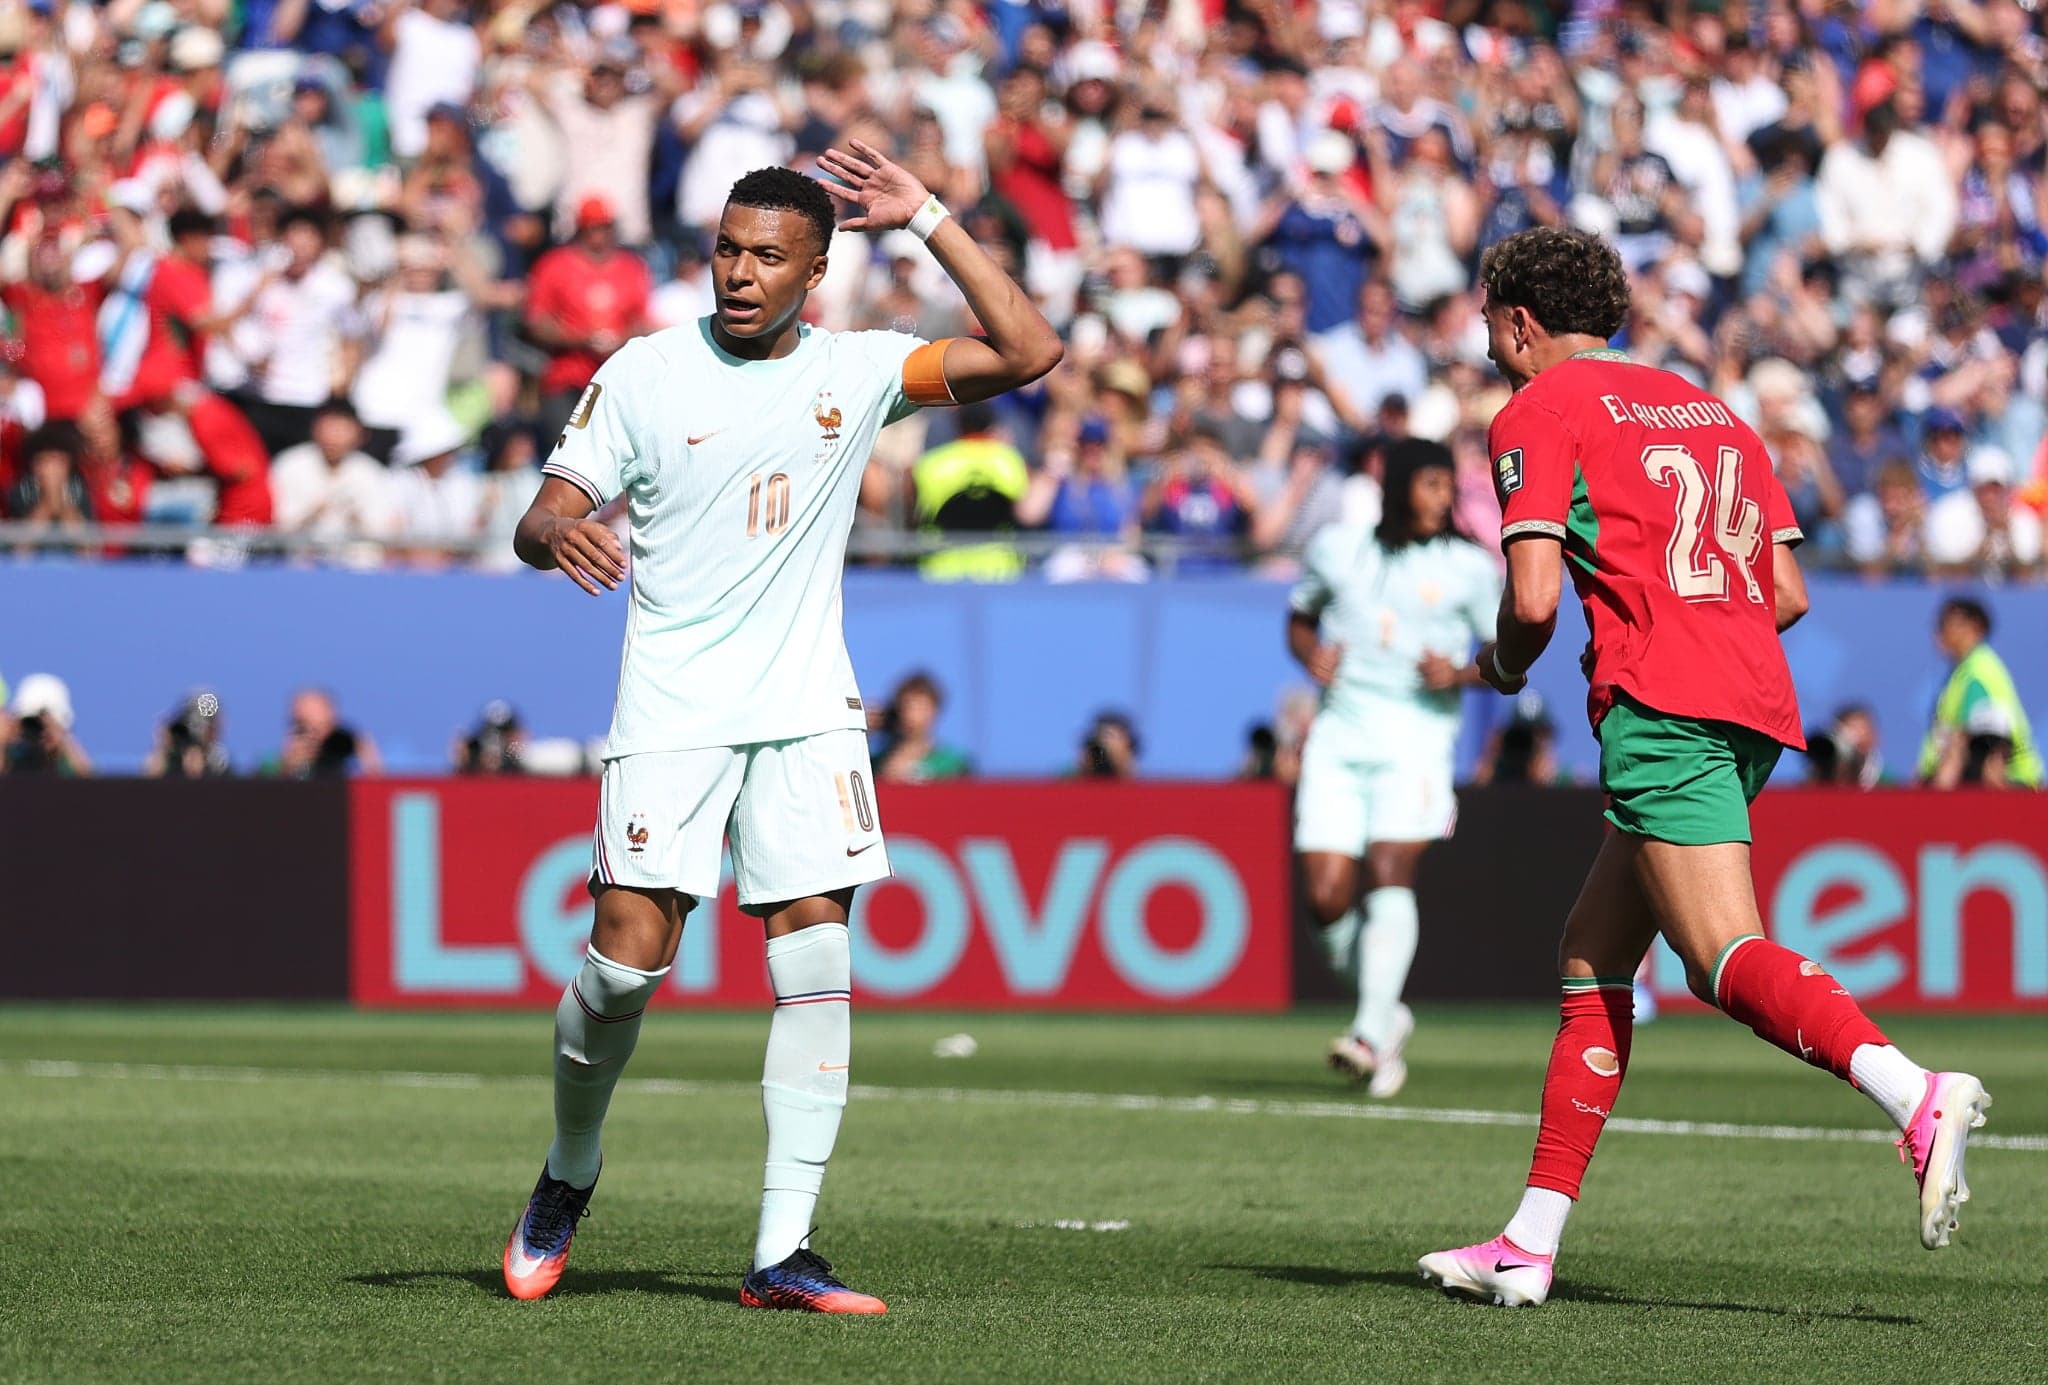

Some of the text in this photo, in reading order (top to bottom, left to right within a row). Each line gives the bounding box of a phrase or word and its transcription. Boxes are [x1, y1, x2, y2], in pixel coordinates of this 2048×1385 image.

[1631, 401, 1735, 430] AYNAOUI
[747, 472, 790, 538] 10
[1640, 444, 1764, 604] 24
[834, 770, 874, 832] 10
